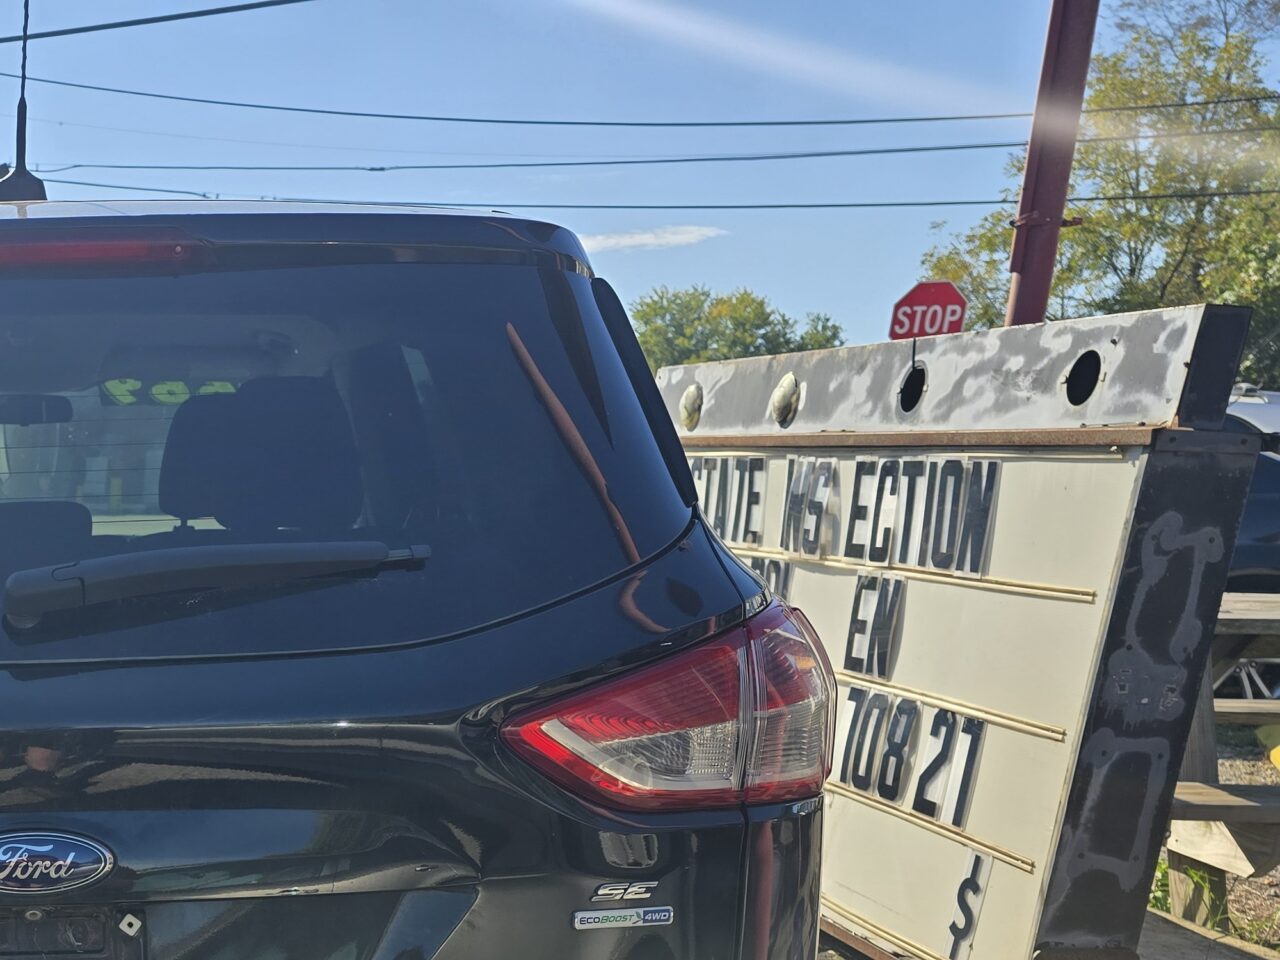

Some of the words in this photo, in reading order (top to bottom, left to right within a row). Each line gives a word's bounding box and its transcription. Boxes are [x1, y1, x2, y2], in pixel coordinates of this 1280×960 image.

[894, 304, 962, 334] STOP
[591, 881, 658, 901] SE
[645, 912, 669, 921] 4WD
[949, 854, 980, 960] $
